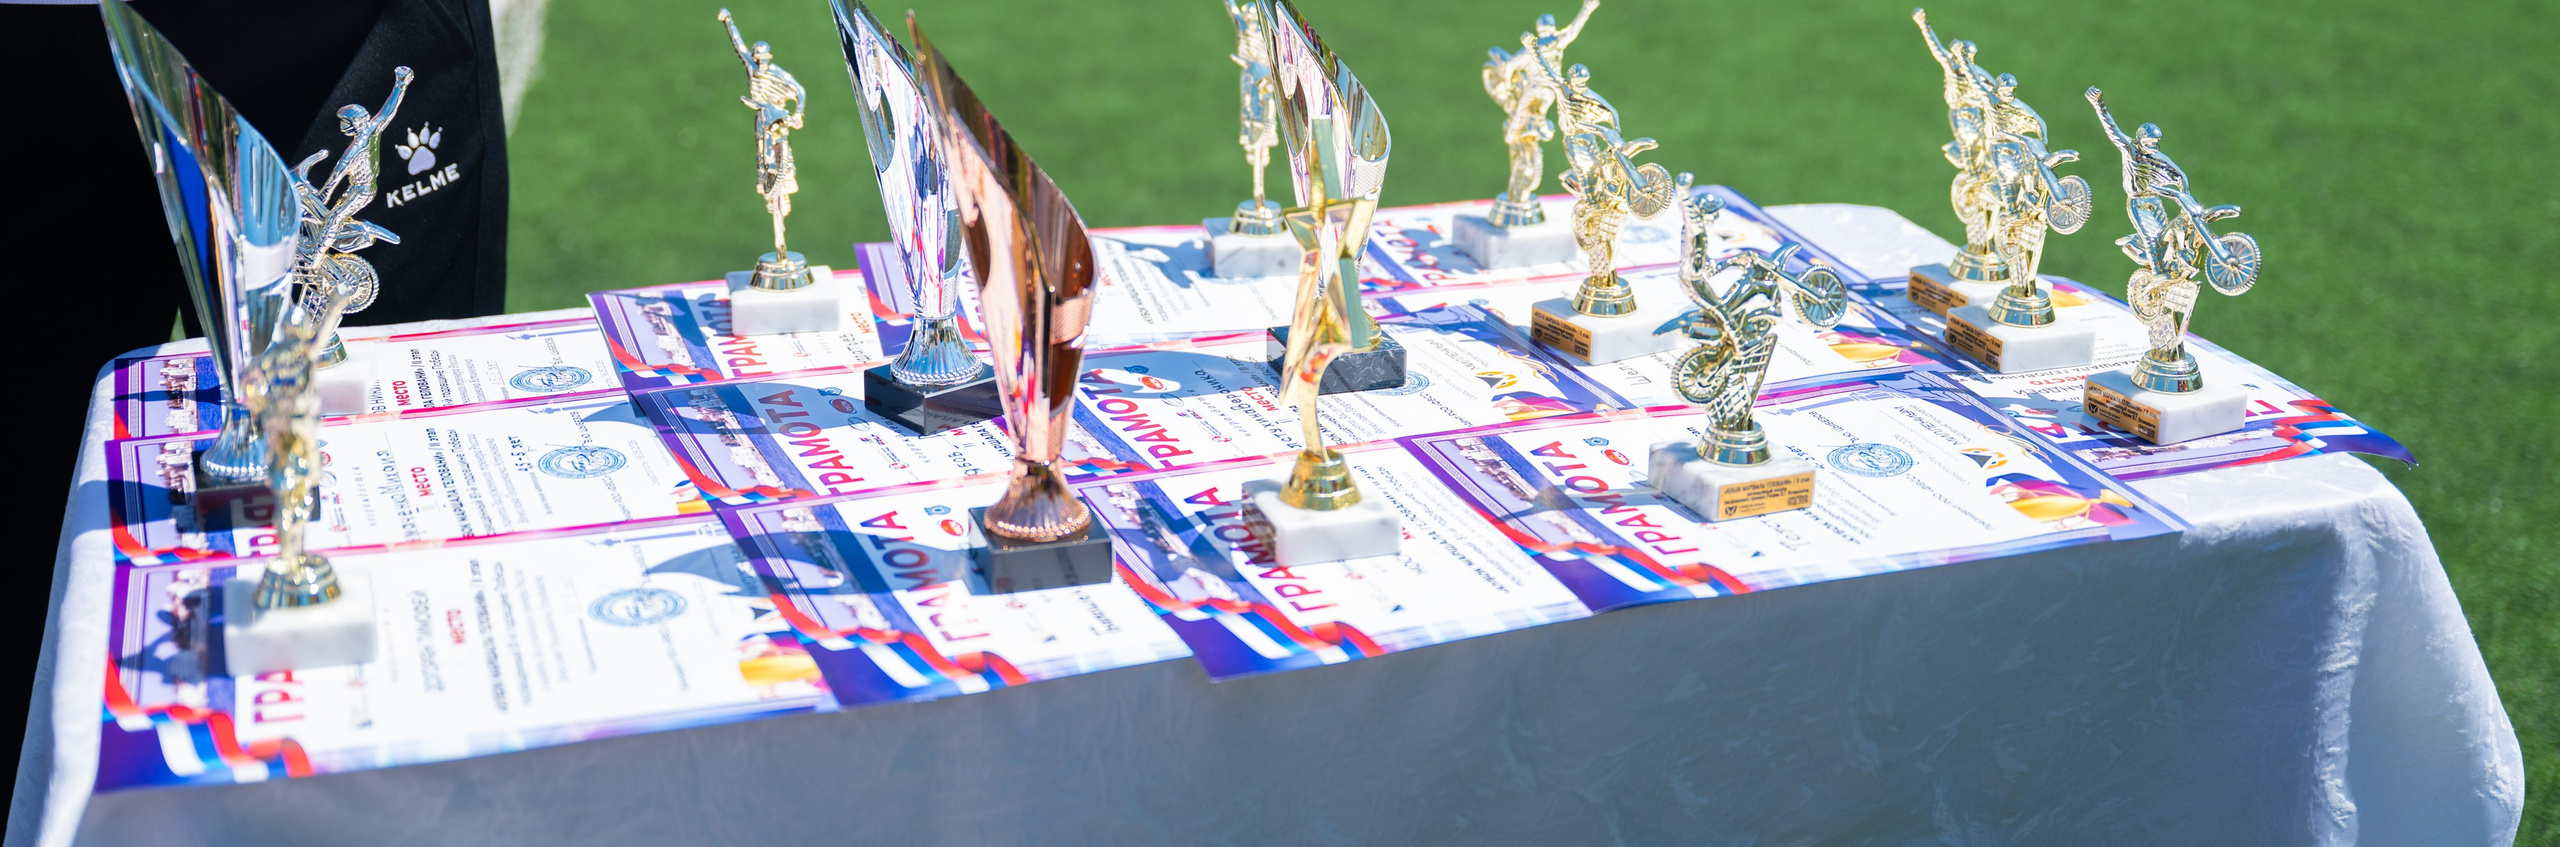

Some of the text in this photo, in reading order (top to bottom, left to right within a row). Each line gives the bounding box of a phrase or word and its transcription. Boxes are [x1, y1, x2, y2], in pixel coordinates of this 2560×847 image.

[386, 162, 461, 209] KELME
[410, 349, 421, 360] этап
[428, 350, 442, 370] Победы
[1226, 356, 1245, 366] этап
[1991, 357, 2143, 382] МАРШАЛА ГЕЛОВАНИ»
[2029, 374, 2090, 386] место
[392, 380, 410, 406] место
[415, 368, 432, 399] ГЕЛОВАНИ»
[1237, 385, 1278, 411] место
[1808, 411, 1844, 431] ЦЫБЕЗОВ
[426, 428, 439, 441] этап
[447, 429, 461, 453] Победы
[977, 428, 1010, 457] МАРШАЛА
[411, 467, 430, 496] место
[434, 452, 454, 488] ГЕЛОВАНИ»
[456, 453, 475, 485] годовщине
[1376, 466, 1403, 491] Победы
[447, 489, 466, 521] МАРШАЛА
[1529, 440, 1700, 557] ГРАМОТА
[1183, 485, 1340, 615] ГРАМОТА
